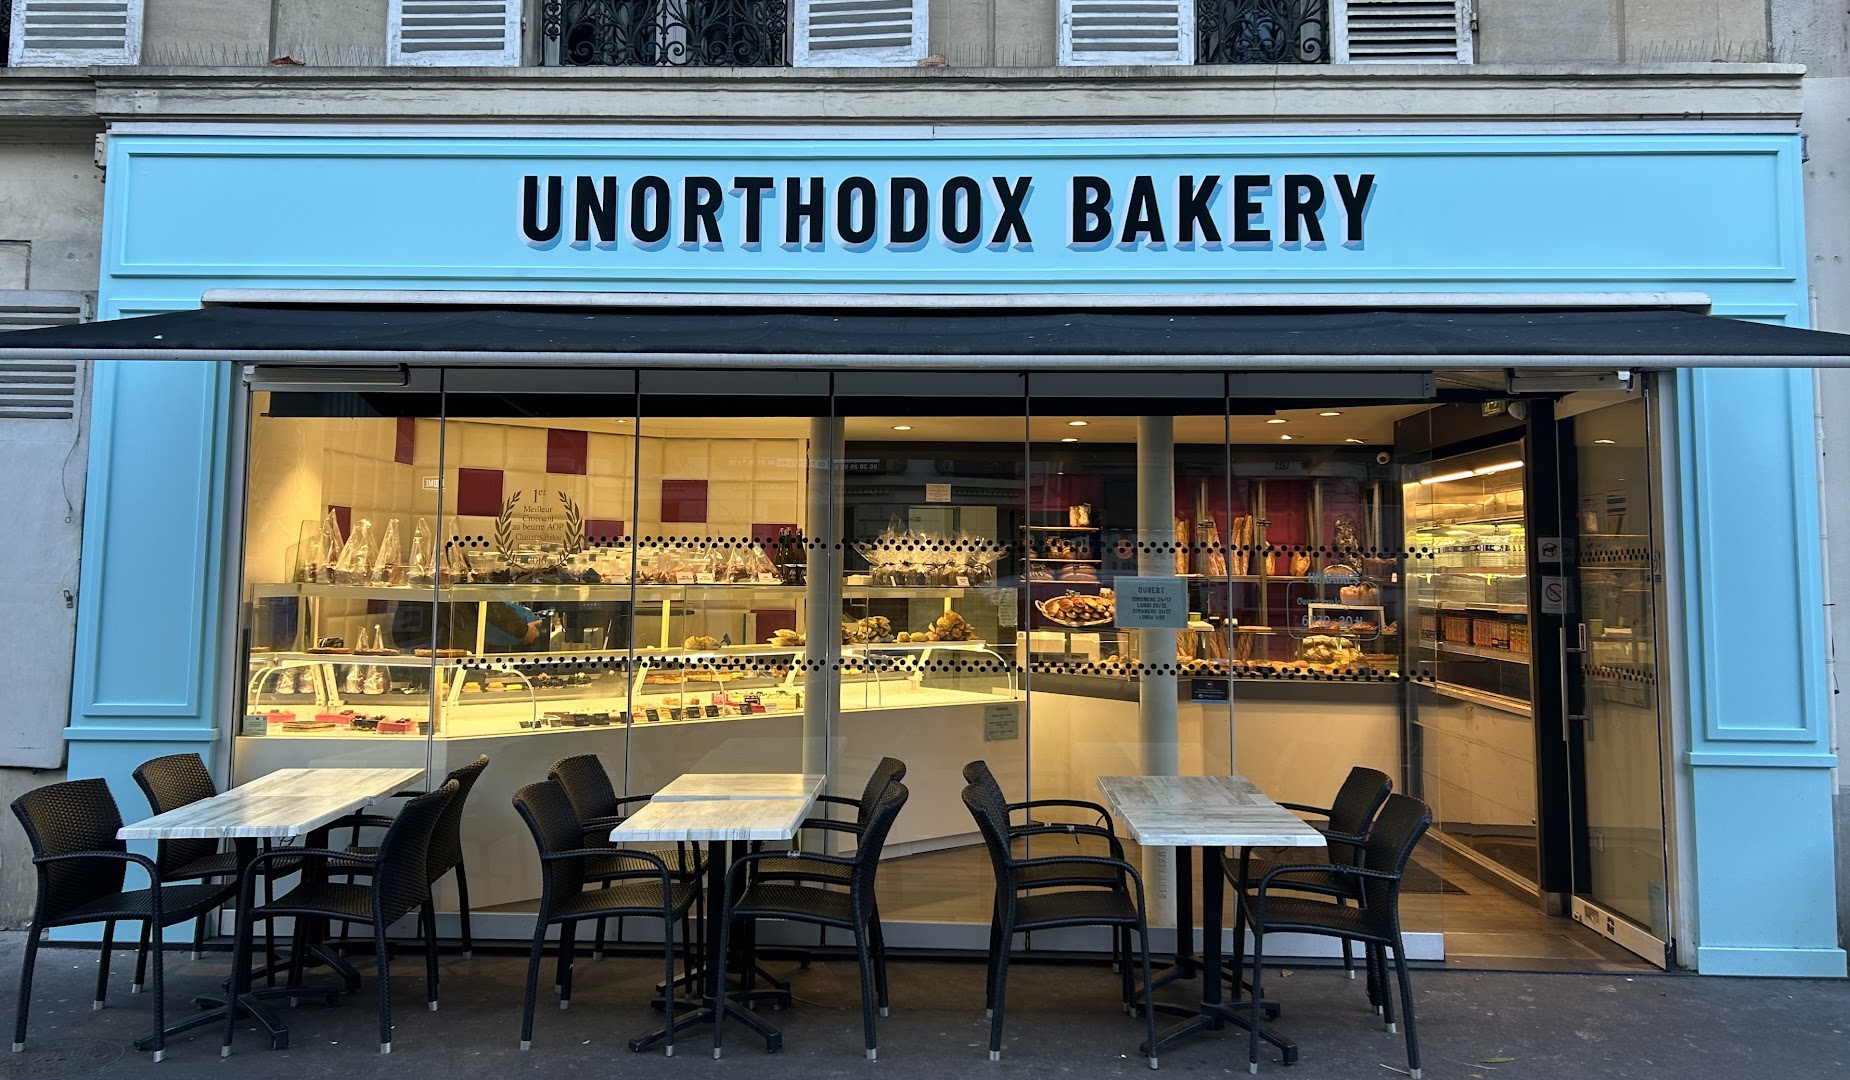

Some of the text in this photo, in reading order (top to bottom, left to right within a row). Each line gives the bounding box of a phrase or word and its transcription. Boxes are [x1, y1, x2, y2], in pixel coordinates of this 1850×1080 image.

[519, 173, 1376, 247] UNORTHODOX BAKERY
[523, 505, 553, 513] Meilleur
[522, 514, 554, 522] Croissant
[522, 523, 545, 531] beurre
[547, 523, 565, 531] AOP
